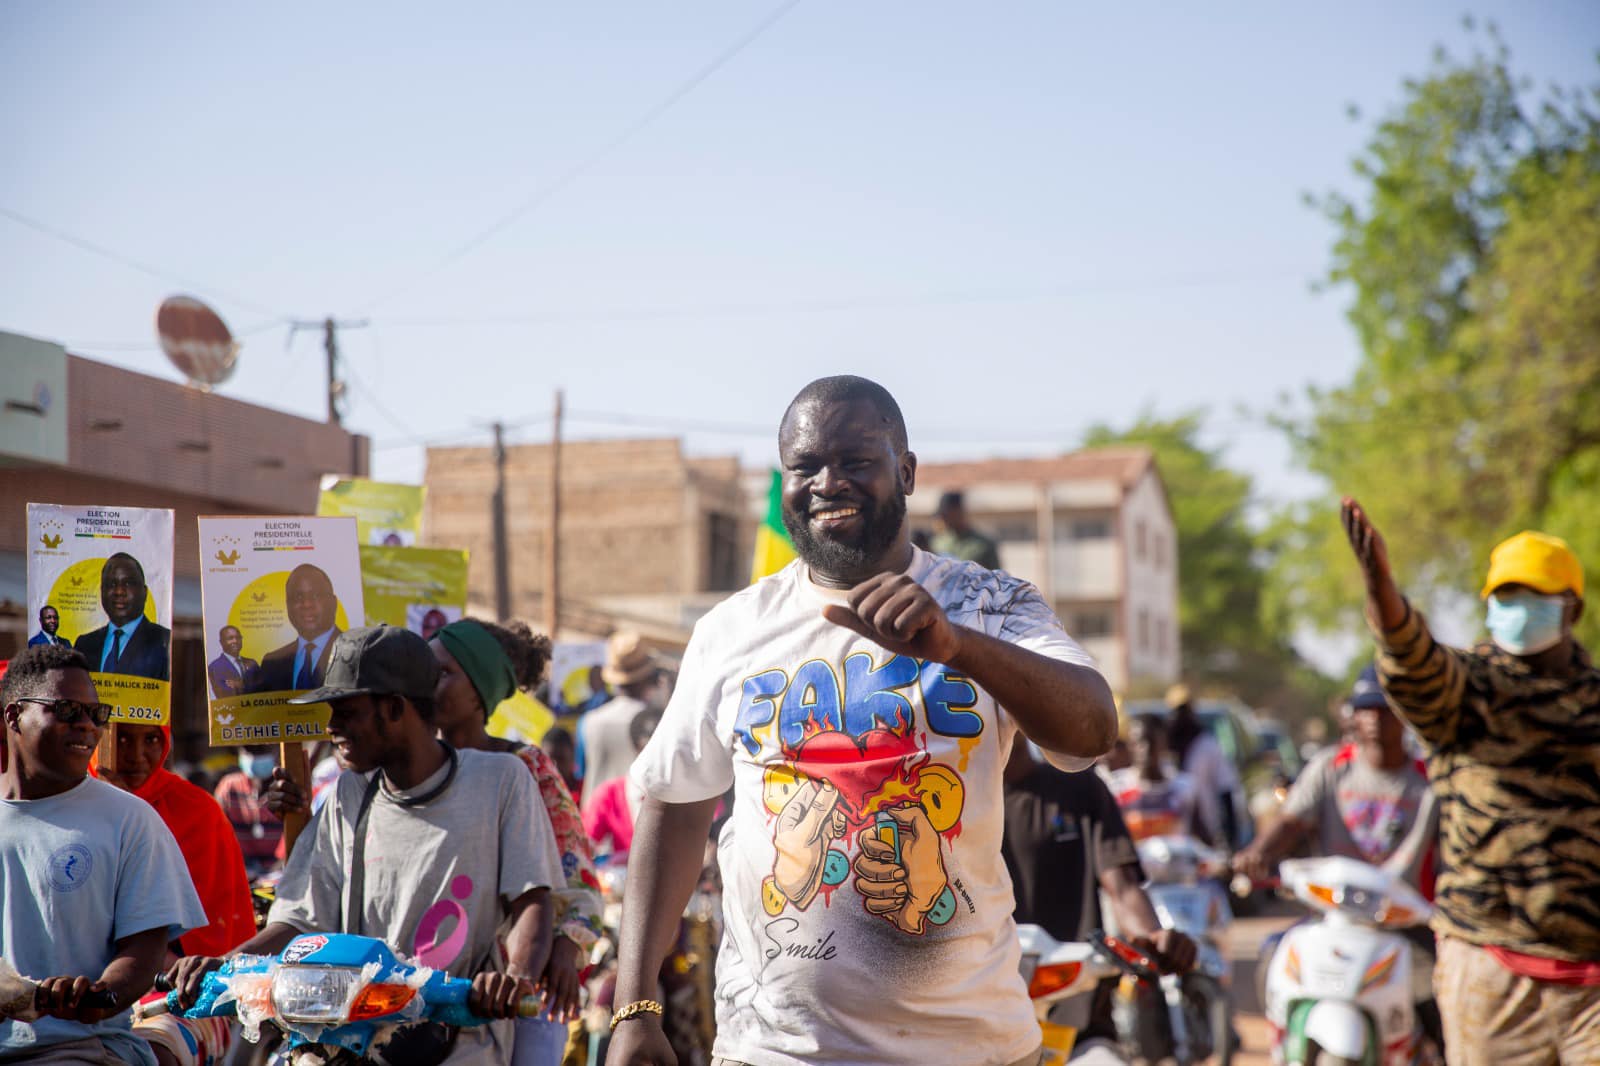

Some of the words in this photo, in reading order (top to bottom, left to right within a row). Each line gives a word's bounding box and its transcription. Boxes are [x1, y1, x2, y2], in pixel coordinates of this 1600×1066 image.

[87, 510, 120, 518] ELECTION
[76, 518, 130, 527] PRESIDENTIELLE
[264, 522, 301, 530] ELECTION
[254, 530, 313, 539] PRESIDENTIELLE
[297, 538, 313, 546] 2024
[104, 679, 112, 687] EL
[114, 681, 141, 689] MALICK
[143, 682, 160, 690] 2024
[733, 651, 984, 757] FAKE
[128, 706, 161, 720] 2024
[285, 722, 323, 737] FALL
[764, 917, 838, 961] Smile
